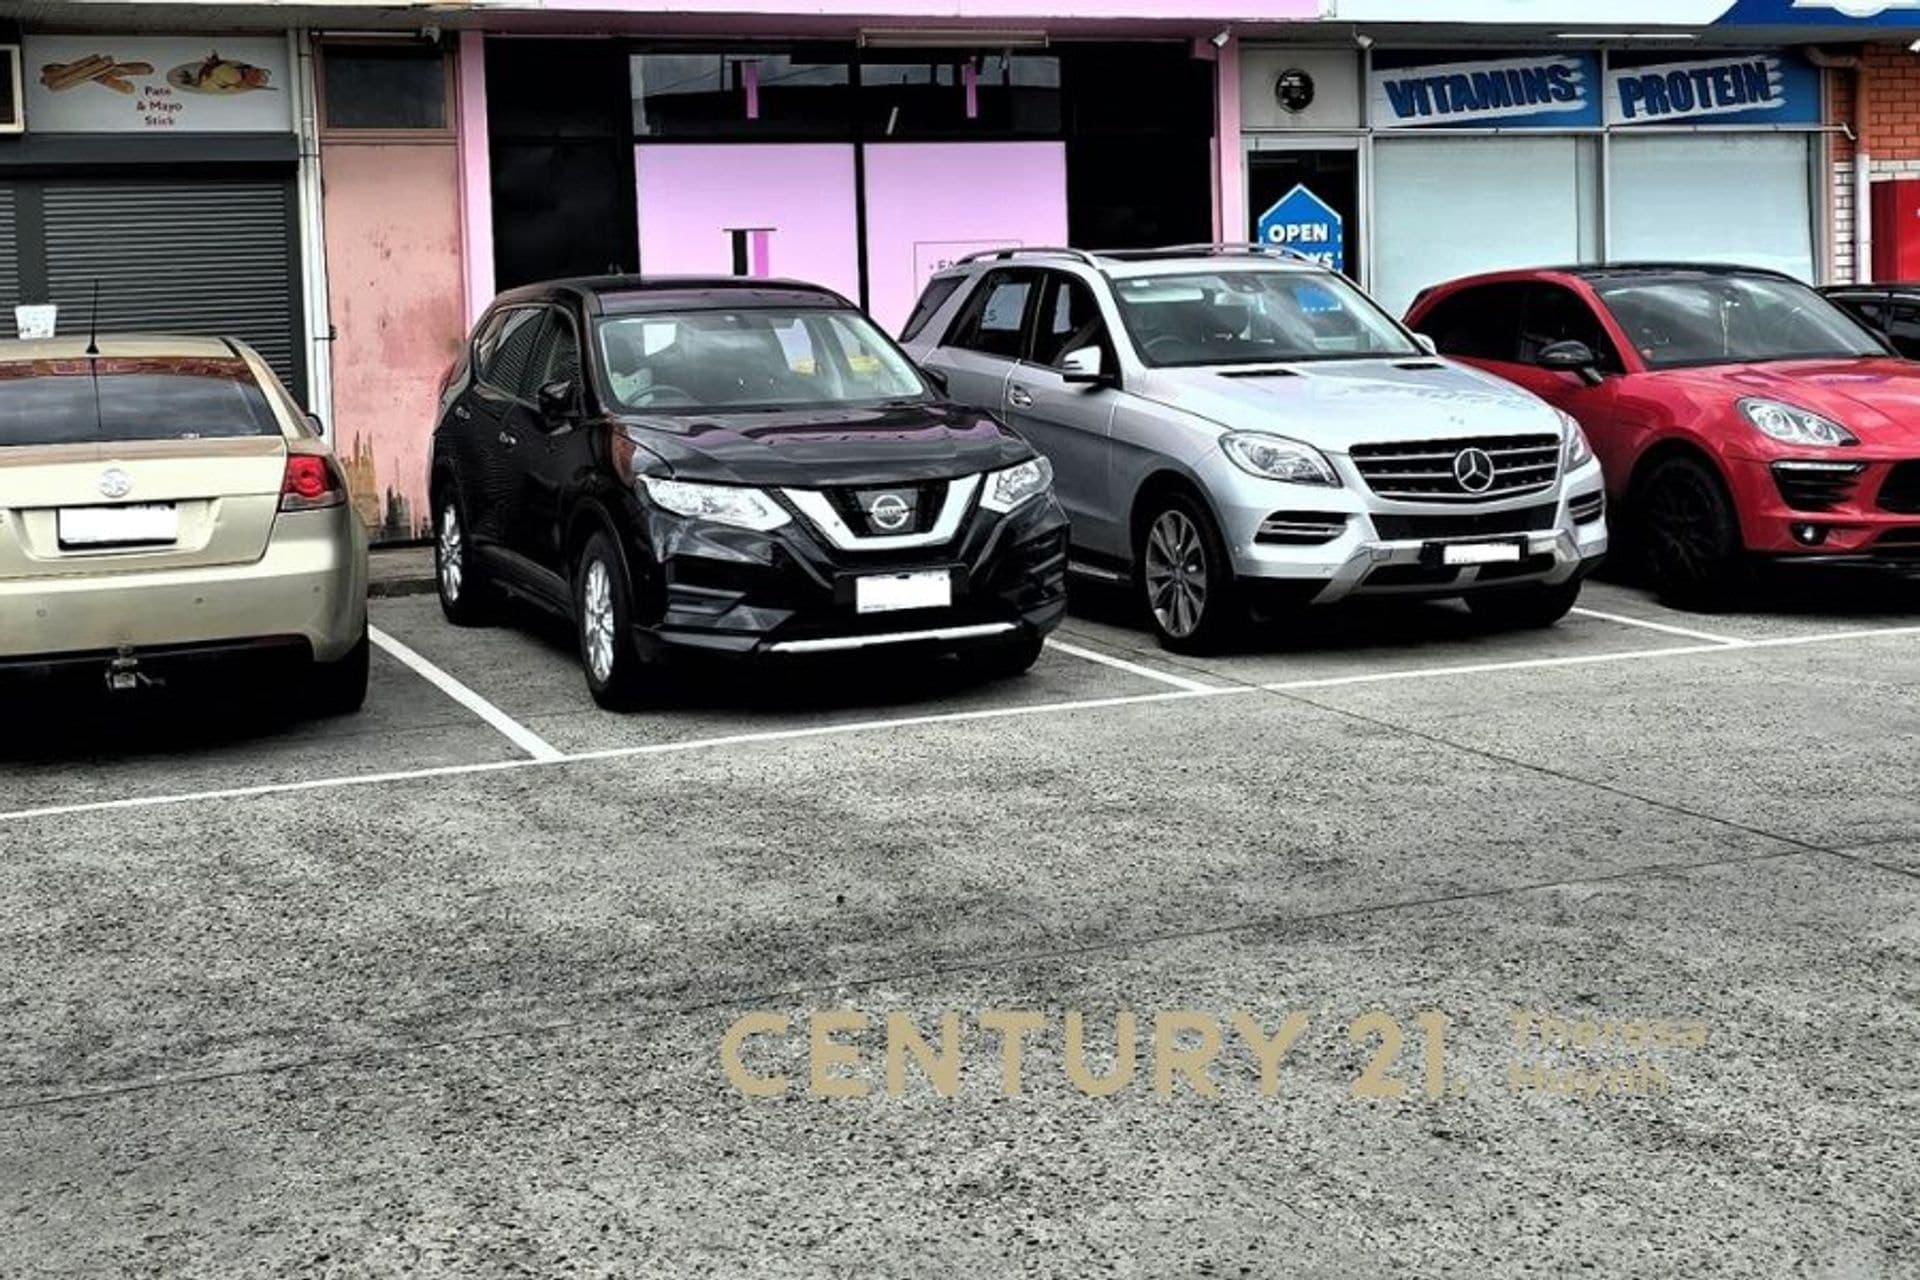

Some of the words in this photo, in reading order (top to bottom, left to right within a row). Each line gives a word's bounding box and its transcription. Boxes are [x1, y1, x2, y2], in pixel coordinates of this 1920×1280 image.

[1383, 64, 1576, 118] VITAMINS
[1617, 62, 1772, 118] PROTEIN
[1268, 223, 1328, 242] OPEN
